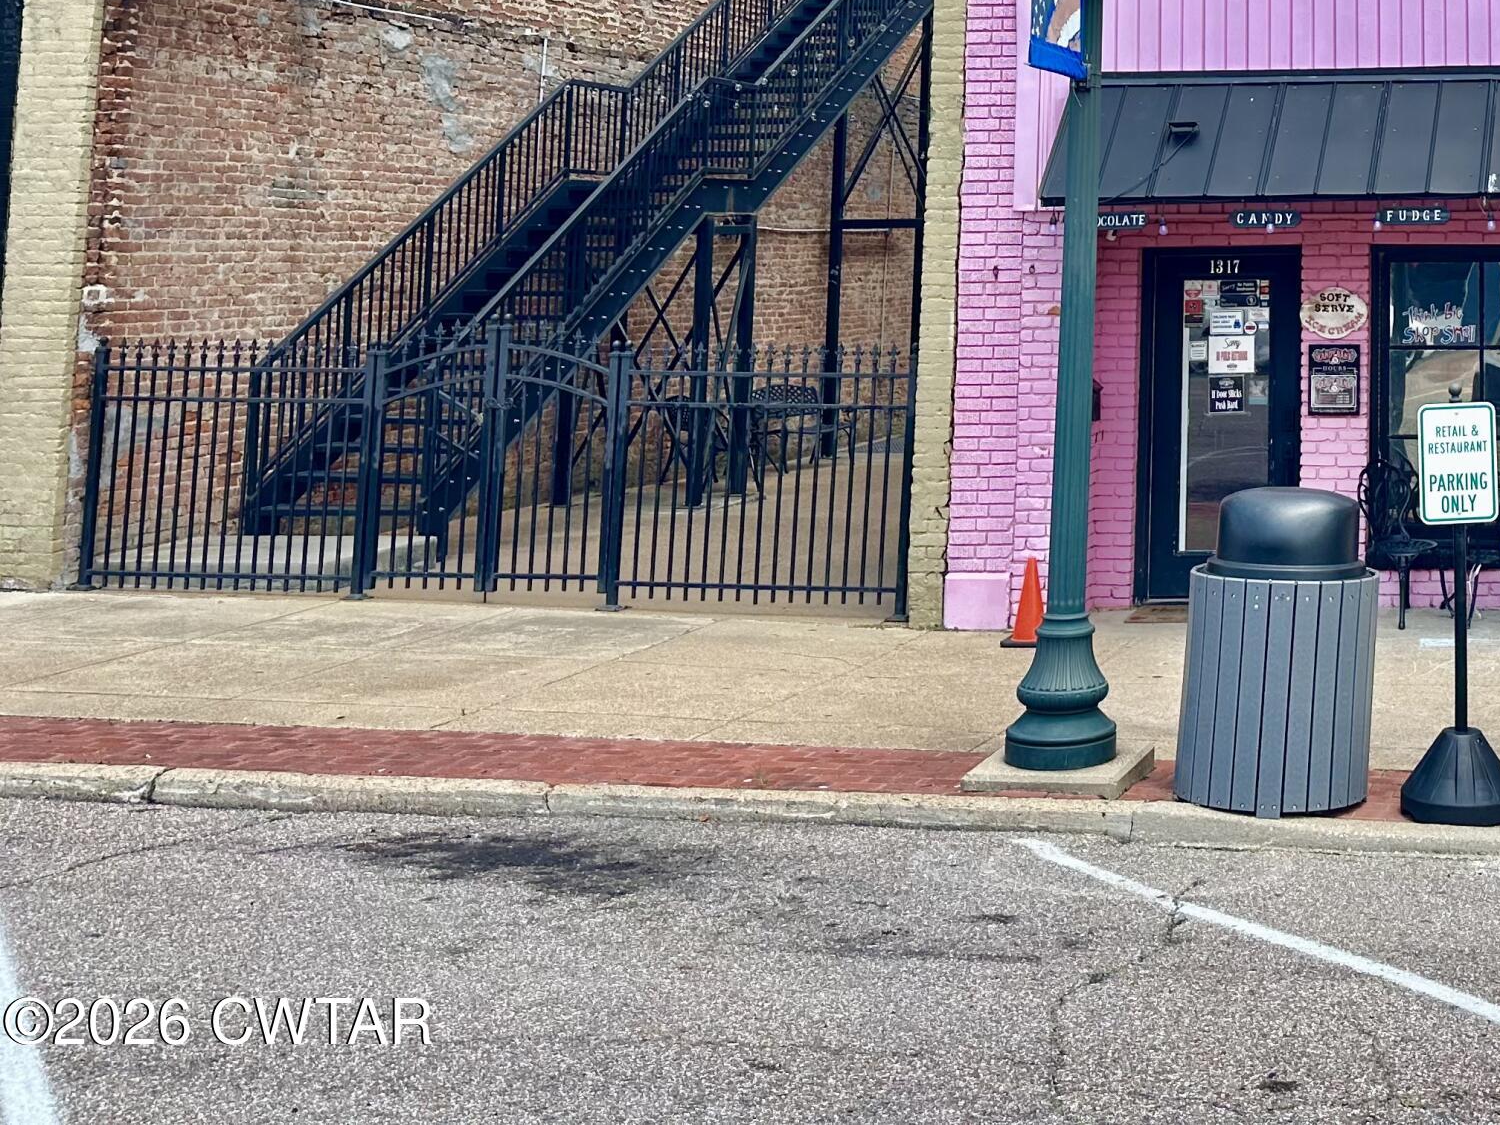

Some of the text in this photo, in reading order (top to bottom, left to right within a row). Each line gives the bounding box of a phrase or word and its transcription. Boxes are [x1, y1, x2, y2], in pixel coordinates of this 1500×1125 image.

[1097, 214, 1146, 227] COLATE
[1236, 212, 1293, 225] CANDY
[1386, 209, 1441, 222] FUDGE
[1210, 259, 1240, 274] 1317
[1319, 292, 1350, 303] SOFT
[1314, 303, 1355, 313] SERVE
[1304, 312, 1364, 335] ICE CREAM
[1435, 424, 1479, 438] RETAIL &
[1428, 440, 1488, 455] RESTAURANT
[1429, 472, 1488, 492] PARKING
[1441, 494, 1477, 514] ONLY
